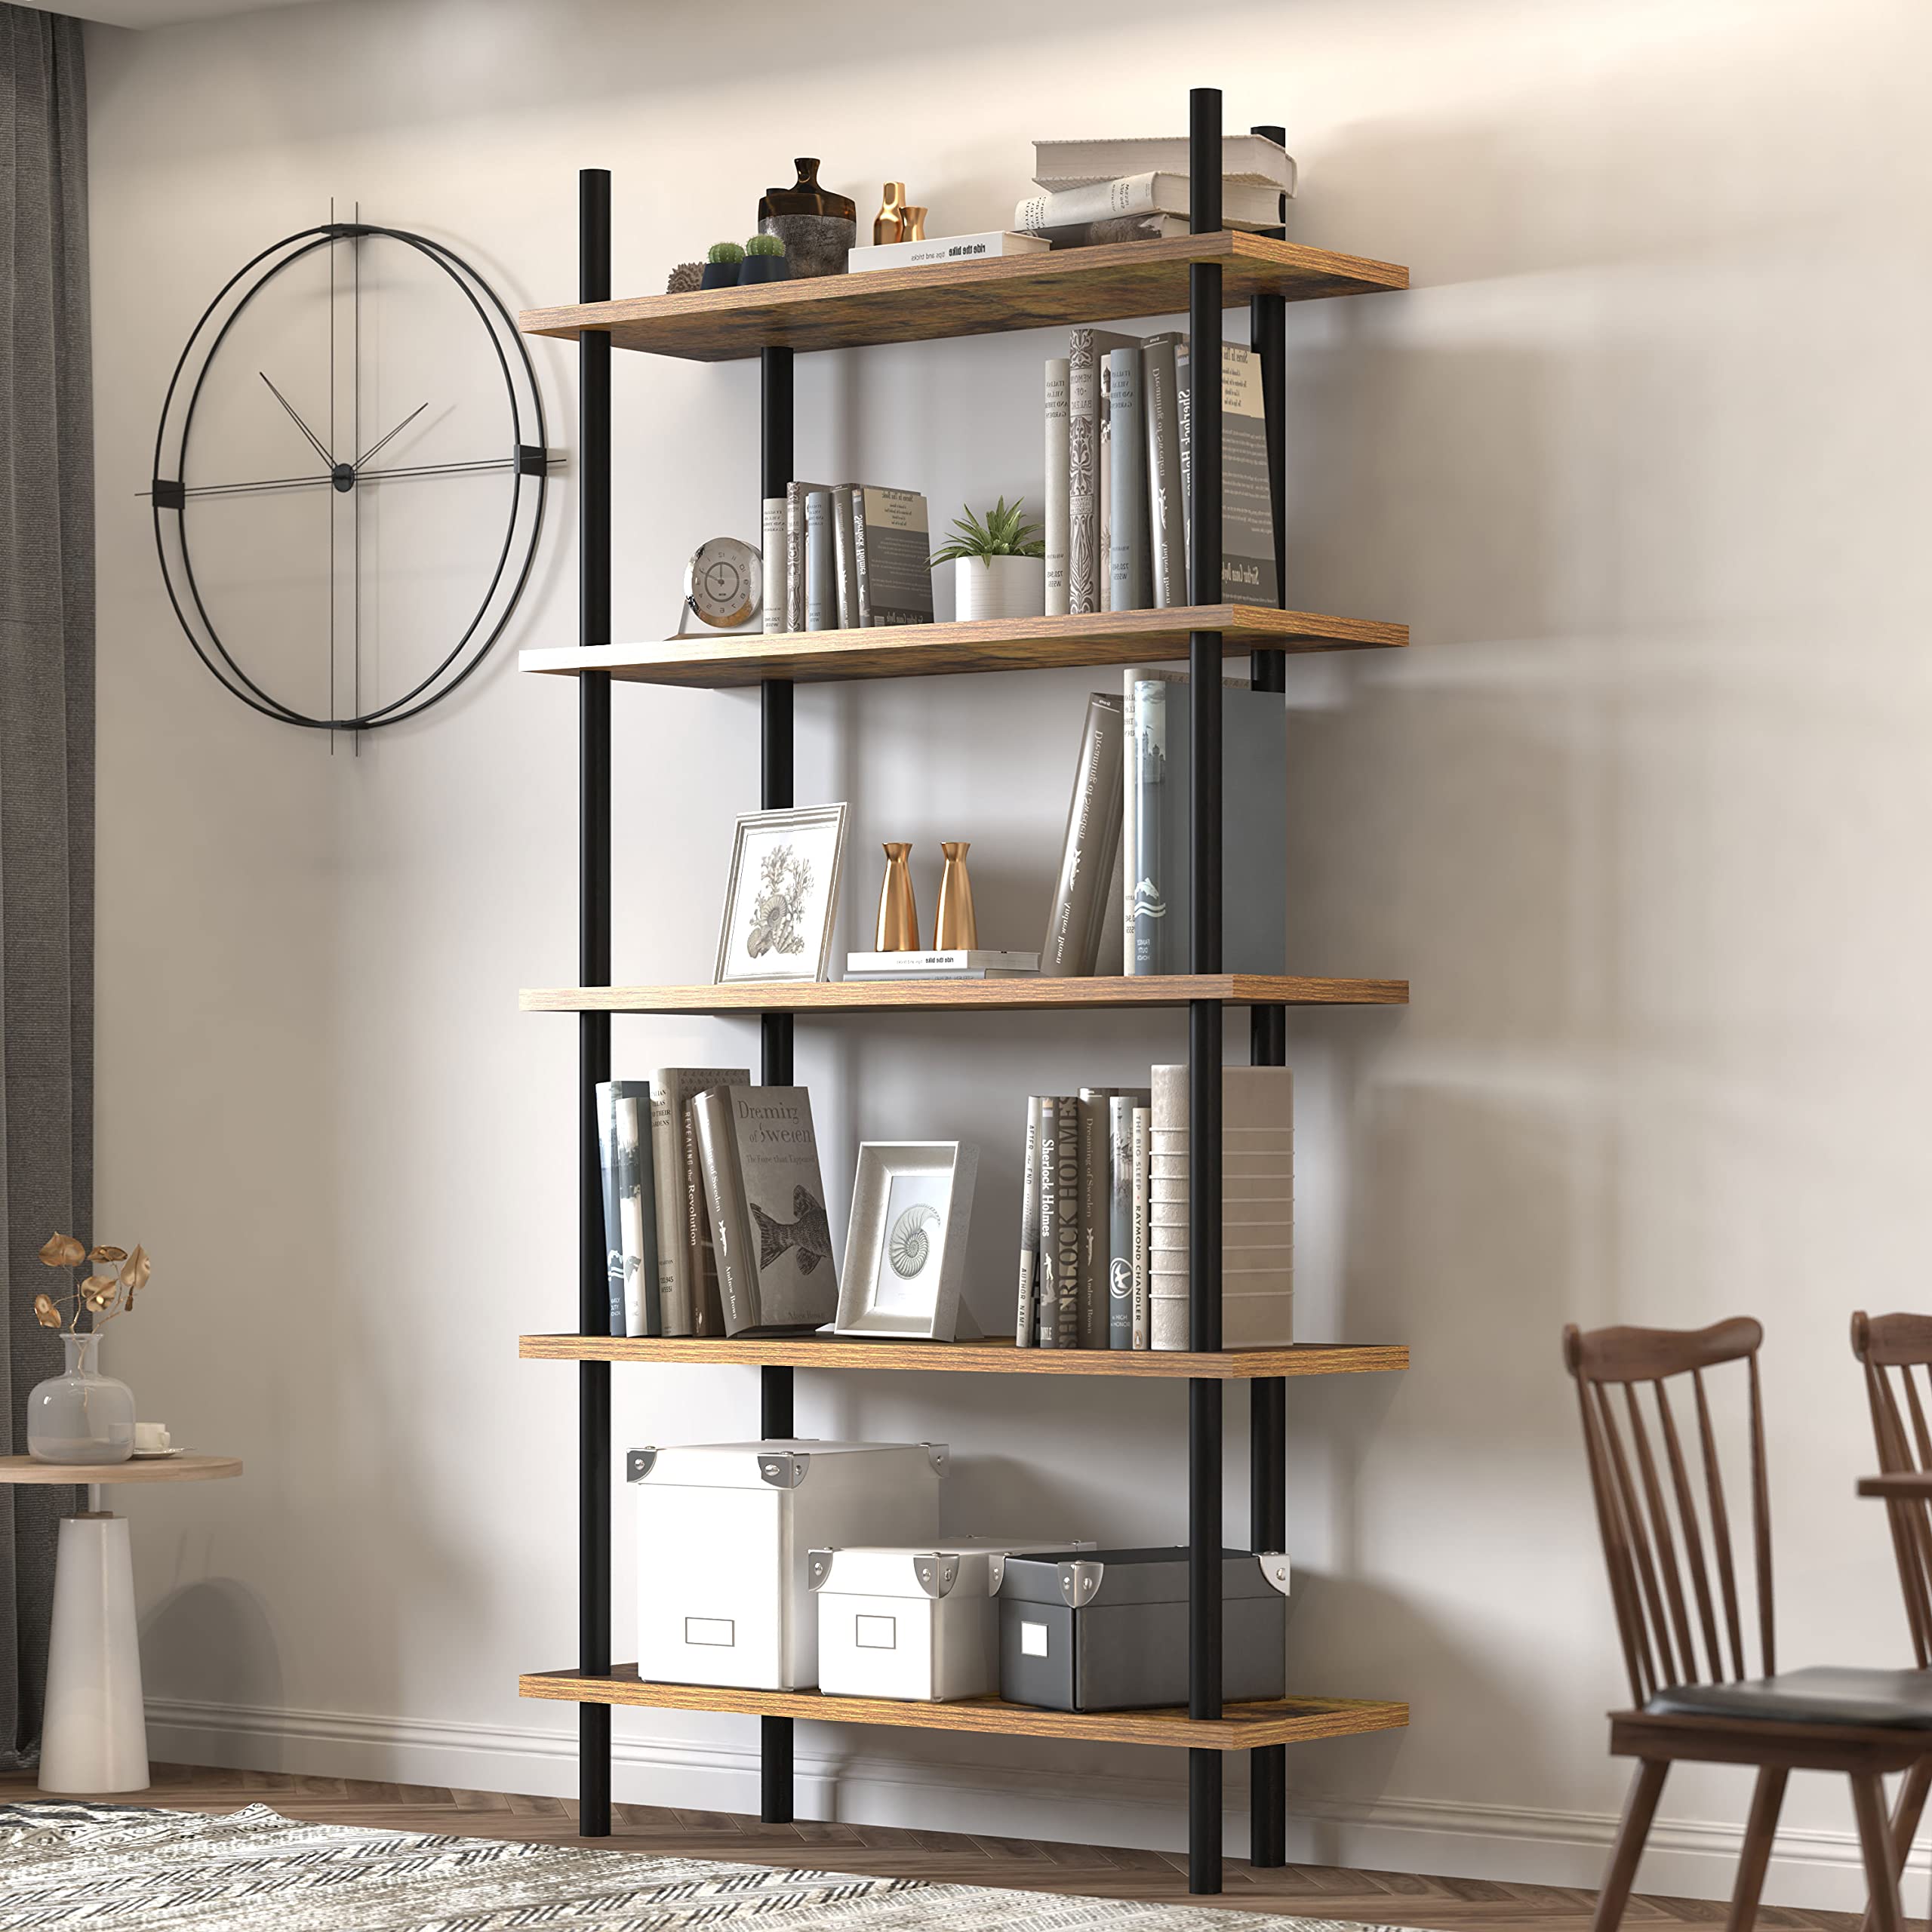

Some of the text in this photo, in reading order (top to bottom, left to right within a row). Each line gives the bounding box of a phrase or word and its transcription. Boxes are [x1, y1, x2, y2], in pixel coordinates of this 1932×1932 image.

[684, 1111, 694, 1165] REVEALING
[749, 1130, 758, 1143] of
[1085, 1118, 1094, 1166] Dreaming
[712, 1175, 721, 1213] Sweden
[1041, 1139, 1054, 1238] Sherlock Holmes
[688, 1184, 697, 1246] Revolution
